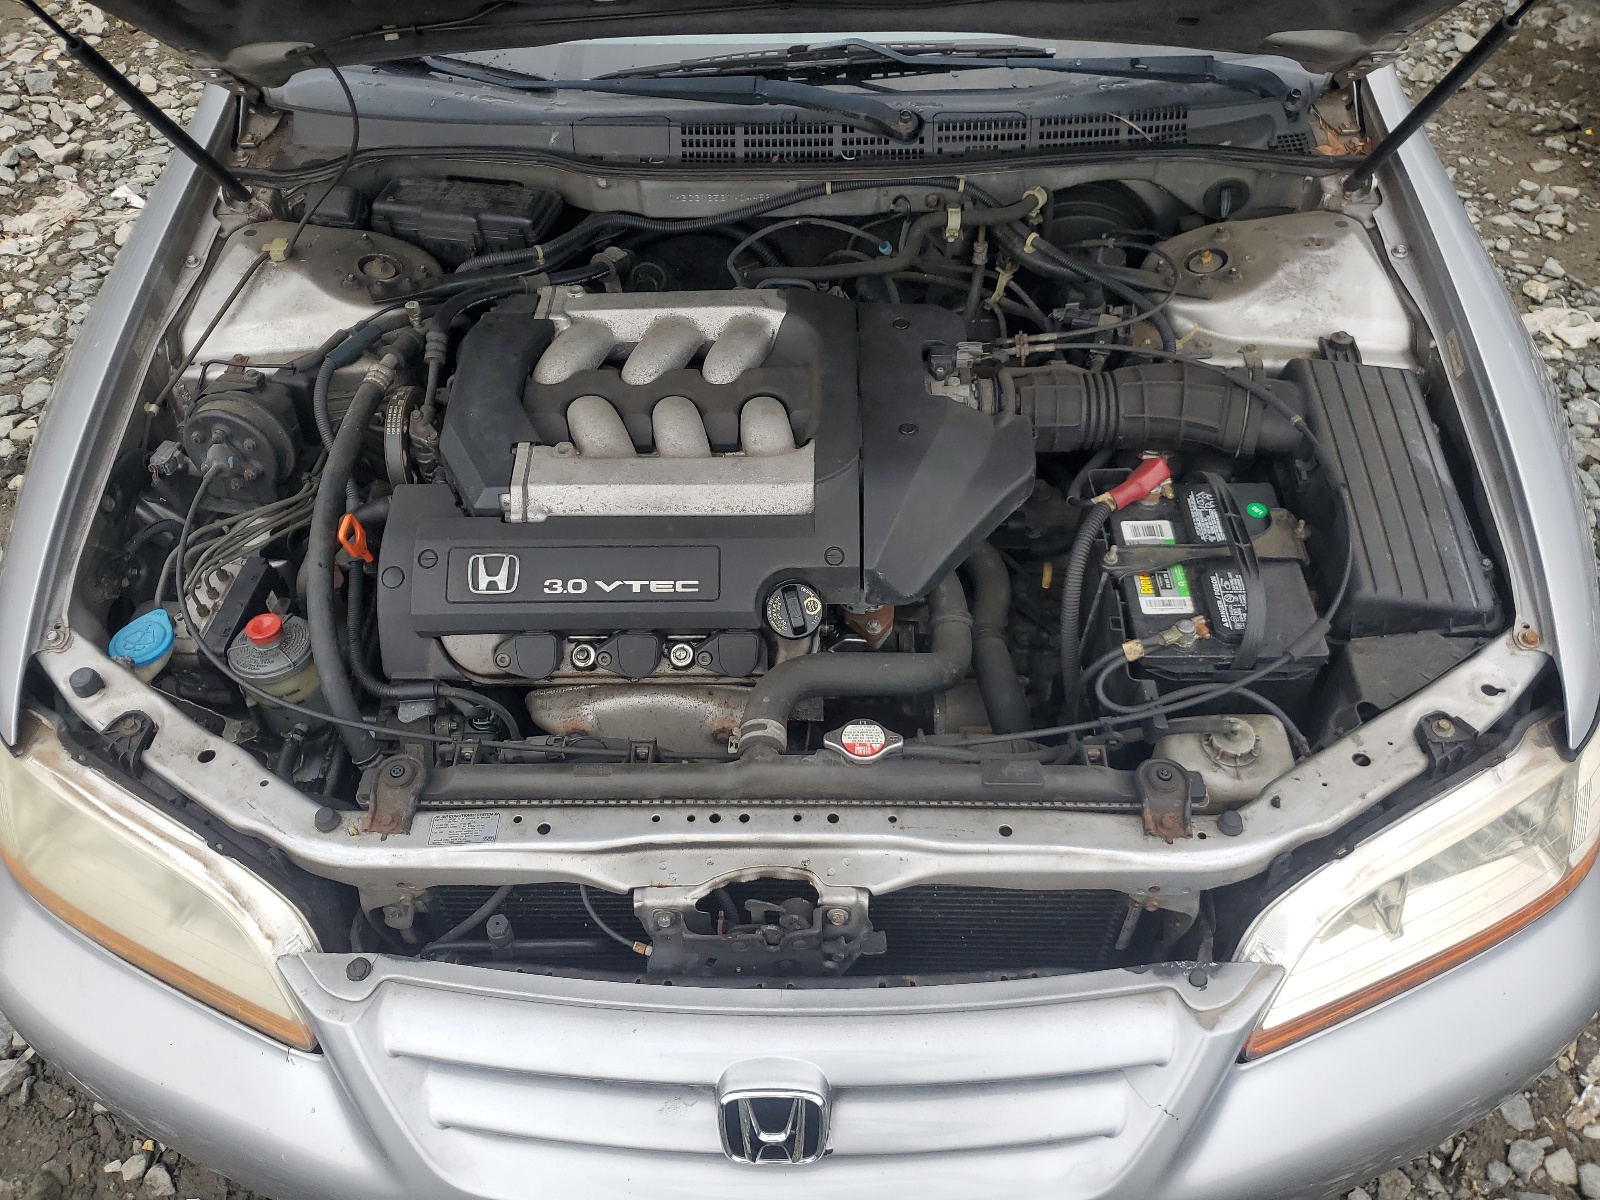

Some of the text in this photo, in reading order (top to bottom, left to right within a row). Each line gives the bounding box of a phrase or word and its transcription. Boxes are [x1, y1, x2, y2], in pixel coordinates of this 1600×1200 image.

[543, 579, 699, 594] 3.0 VTEC
[1209, 575, 1221, 596] POISON
